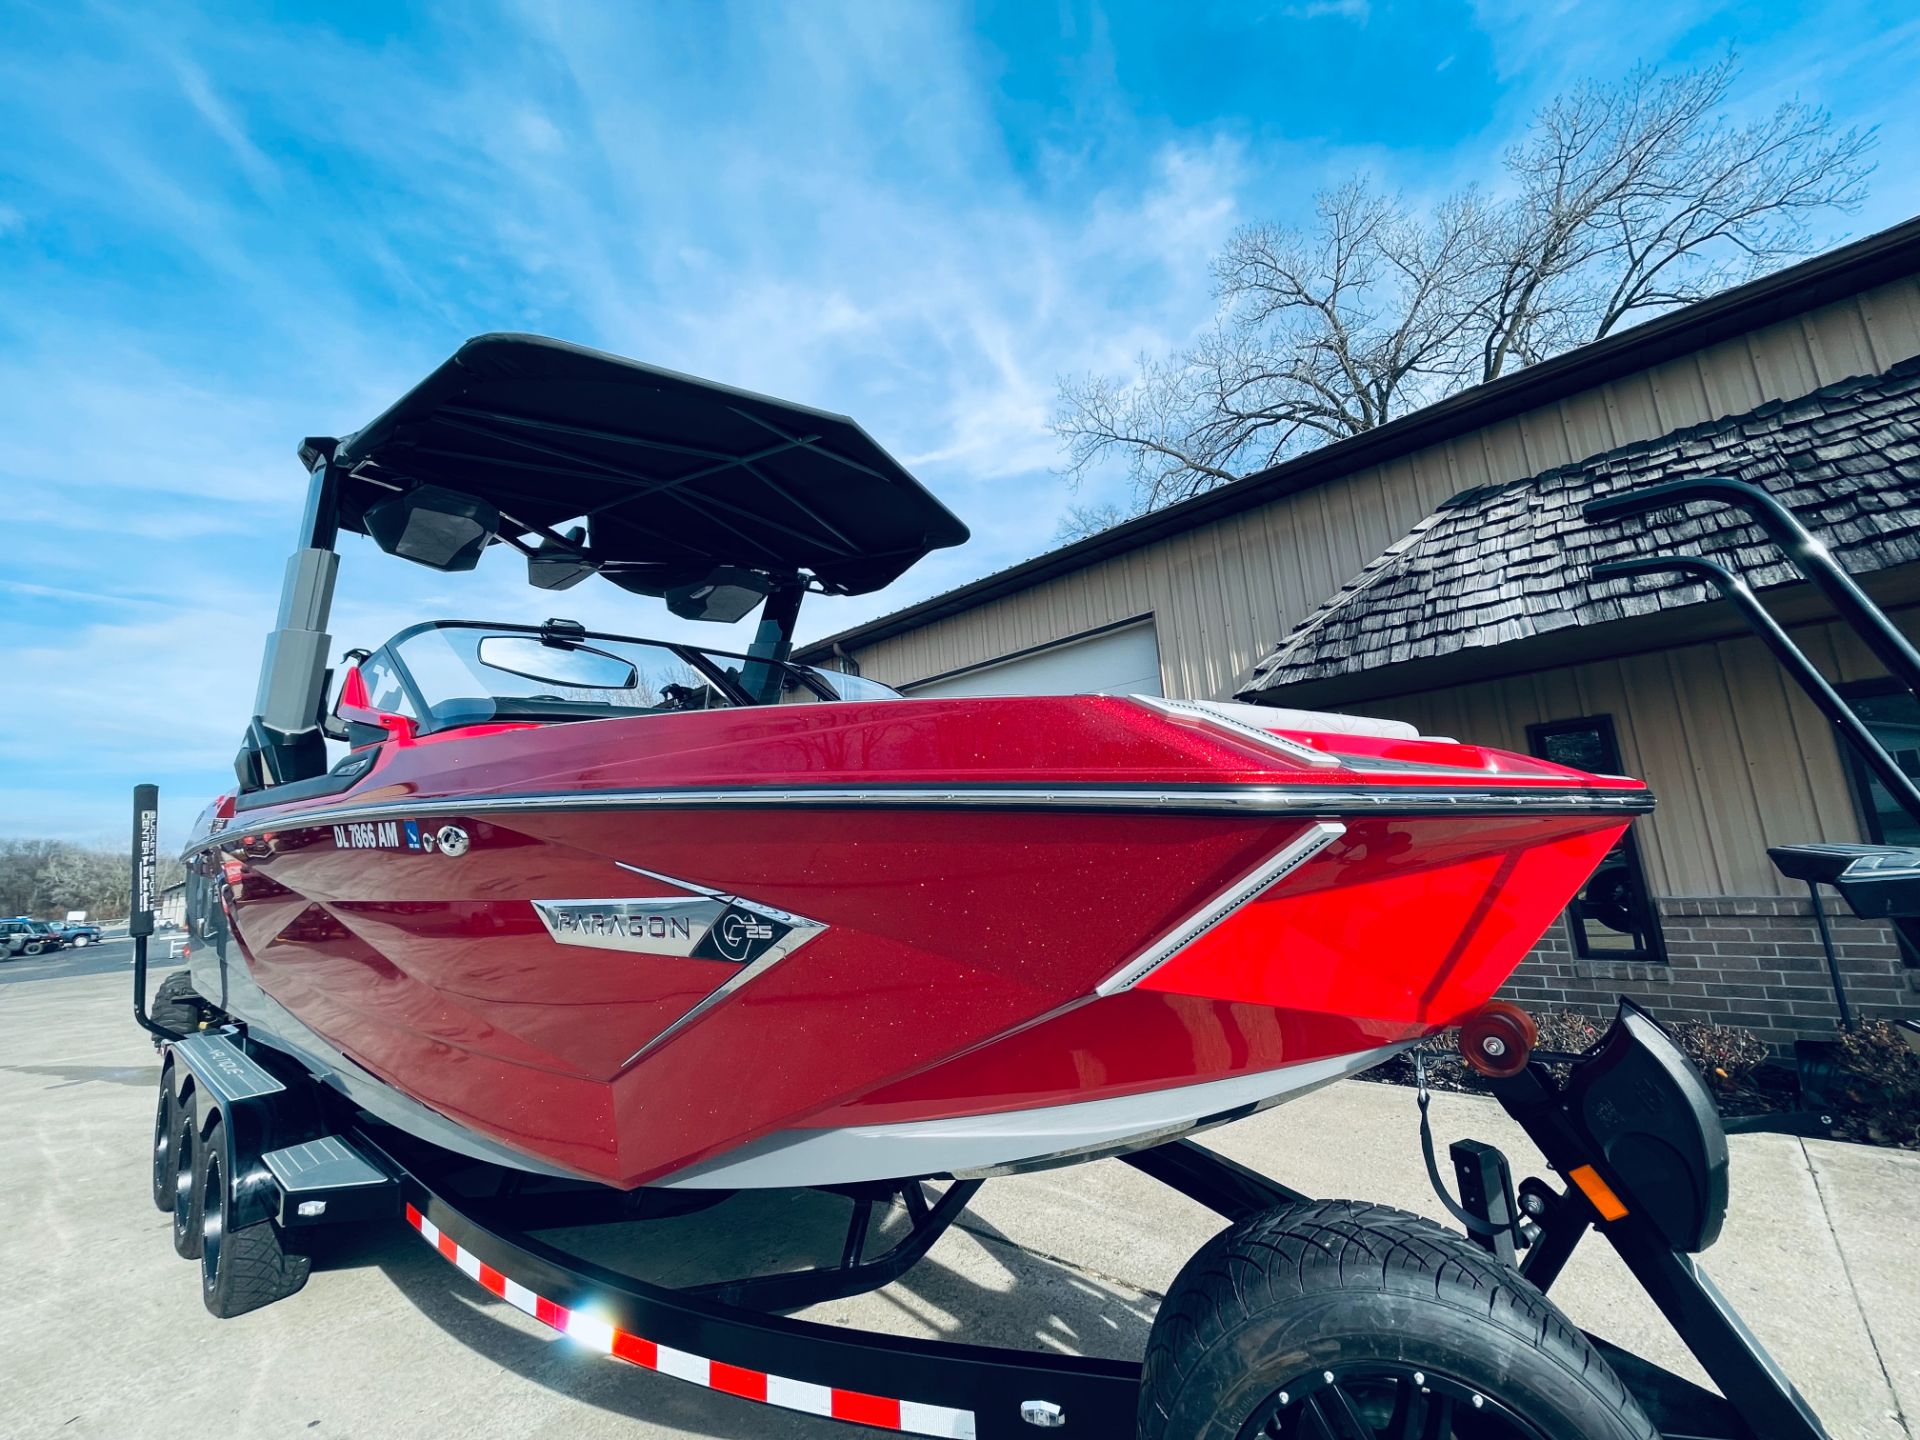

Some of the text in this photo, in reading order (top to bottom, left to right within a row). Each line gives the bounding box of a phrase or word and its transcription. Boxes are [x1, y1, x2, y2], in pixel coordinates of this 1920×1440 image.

[141, 810, 150, 855] CENTER
[149, 810, 157, 862] BUCKEYE
[333, 822, 399, 848] DL 7866 AM
[557, 912, 690, 940] PARAGON
